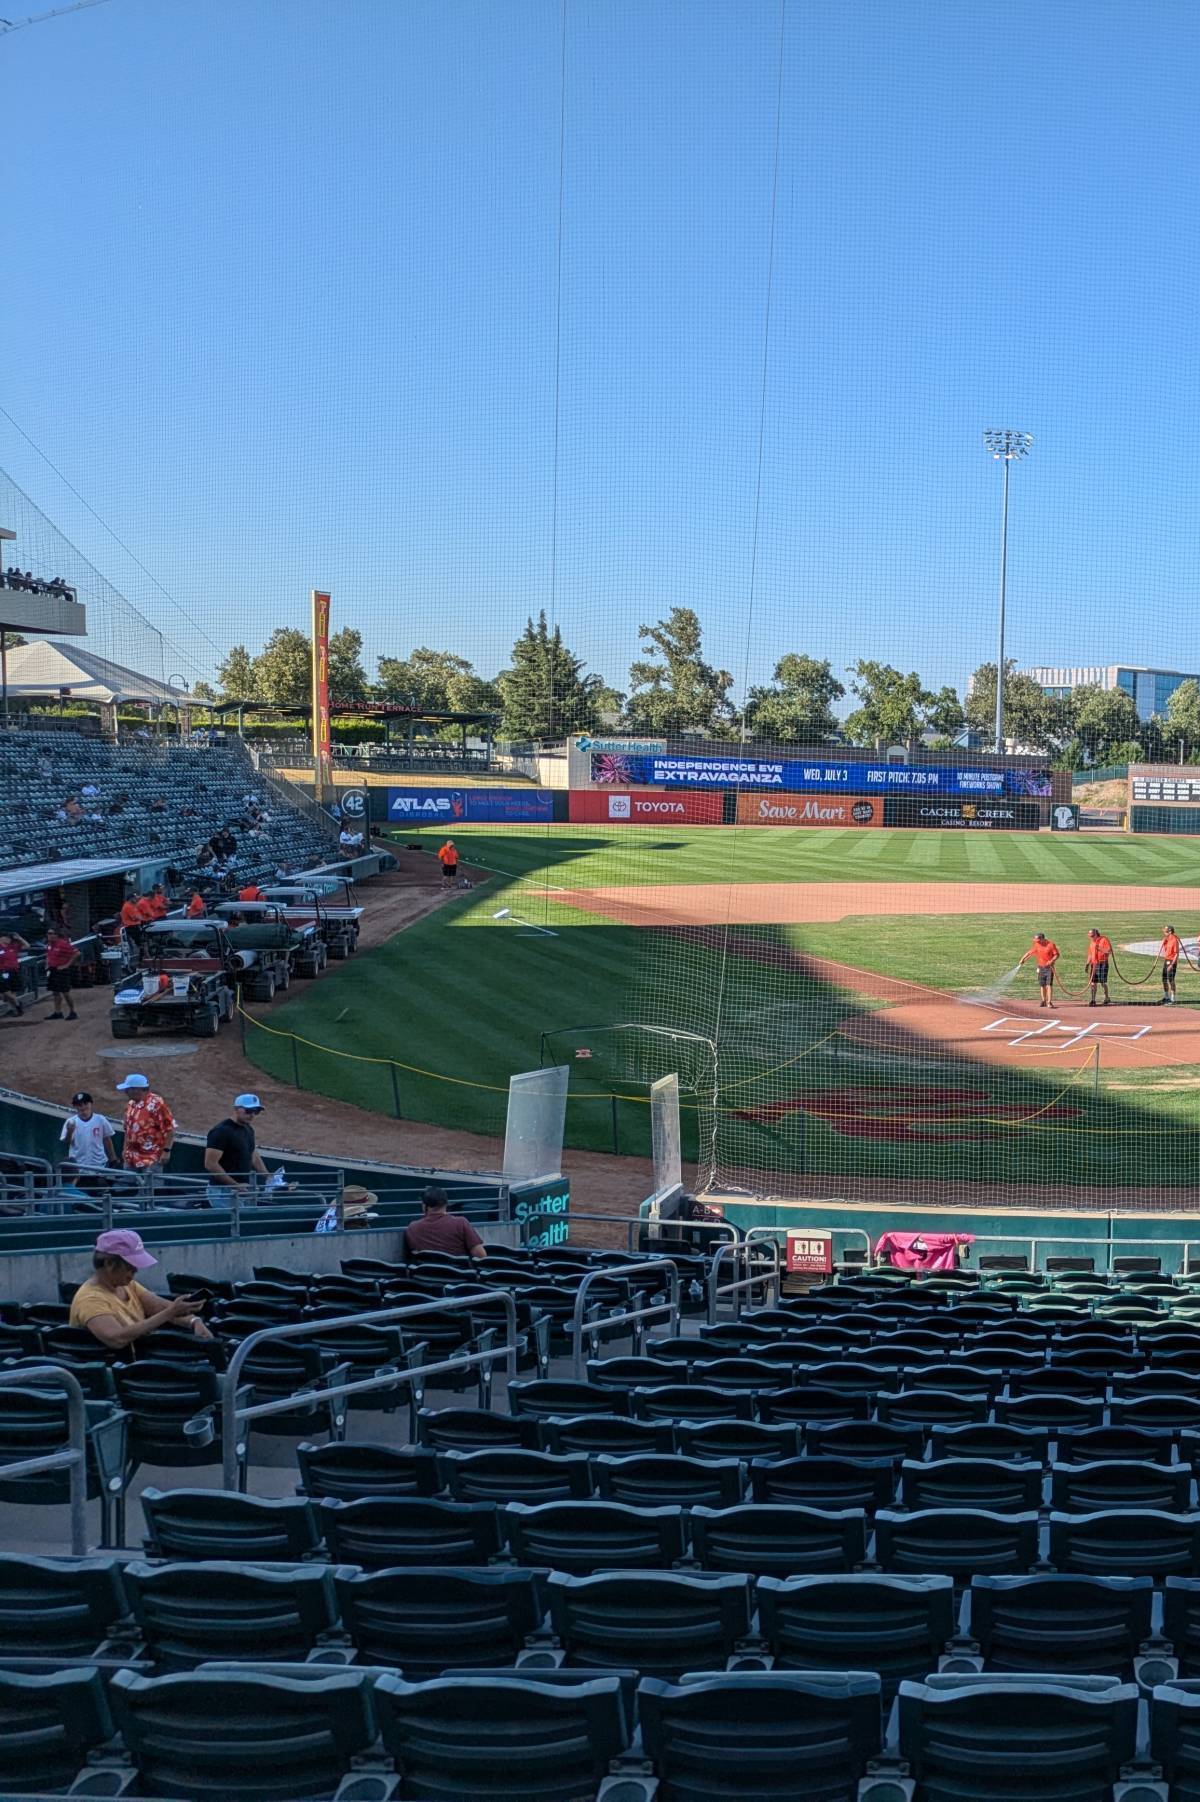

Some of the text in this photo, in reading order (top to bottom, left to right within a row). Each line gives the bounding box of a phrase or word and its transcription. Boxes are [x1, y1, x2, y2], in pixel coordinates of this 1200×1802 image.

[381, 703, 423, 712] TERRACE
[592, 740, 662, 754] Sutter Health
[654, 760, 783, 773] INDEPENDENCE EVE
[653, 770, 783, 784] EXTRAVAGANZA
[803, 768, 848, 782] WED, JULY 3
[867, 770, 886, 783] FIRST
[928, 773, 939, 785] PM
[346, 796, 364, 811] 42
[391, 797, 450, 811] ATLAS
[635, 801, 685, 813] TOYOTA
[758, 799, 798, 818] Save
[799, 800, 846, 820] Mart
[920, 807, 1014, 819] CACHE CREEK
[941, 819, 993, 828] CASINO RESORT
[515, 1193, 570, 1223] Sutter
[520, 1221, 569, 1247] ealth
